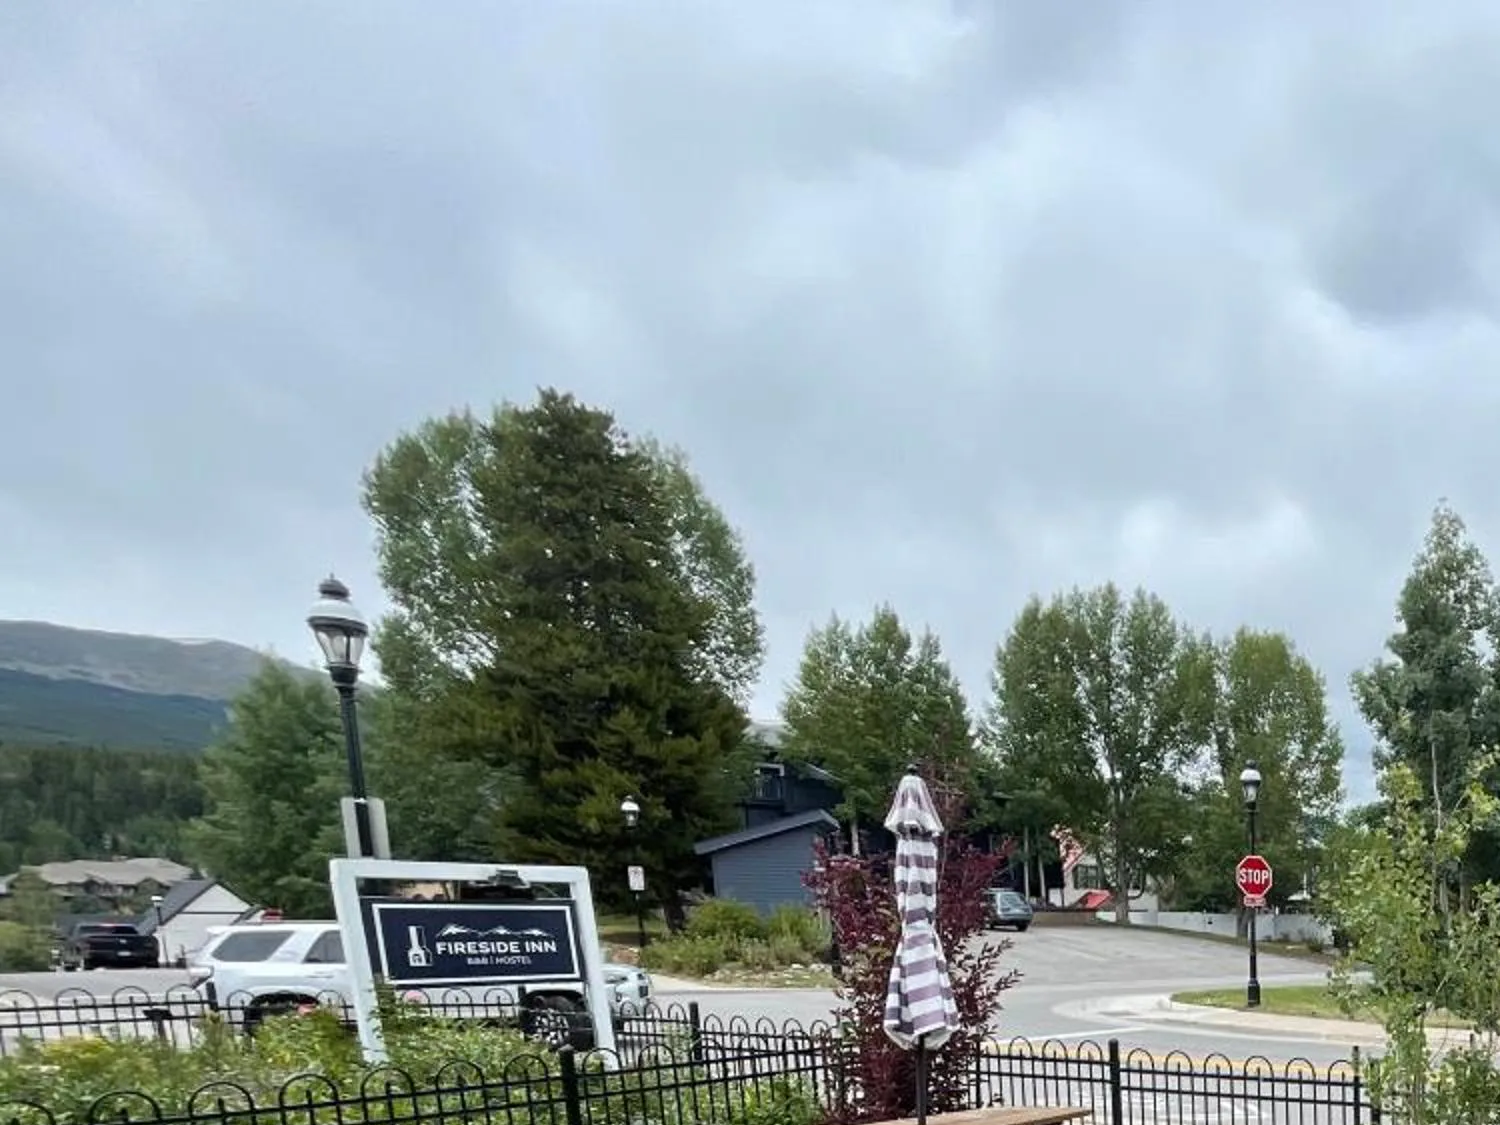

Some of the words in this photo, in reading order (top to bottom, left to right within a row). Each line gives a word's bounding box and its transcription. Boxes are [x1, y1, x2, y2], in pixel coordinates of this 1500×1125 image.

[1239, 868, 1268, 885] STOP
[435, 941, 521, 955] FIRESIDE
[525, 941, 557, 953] INN
